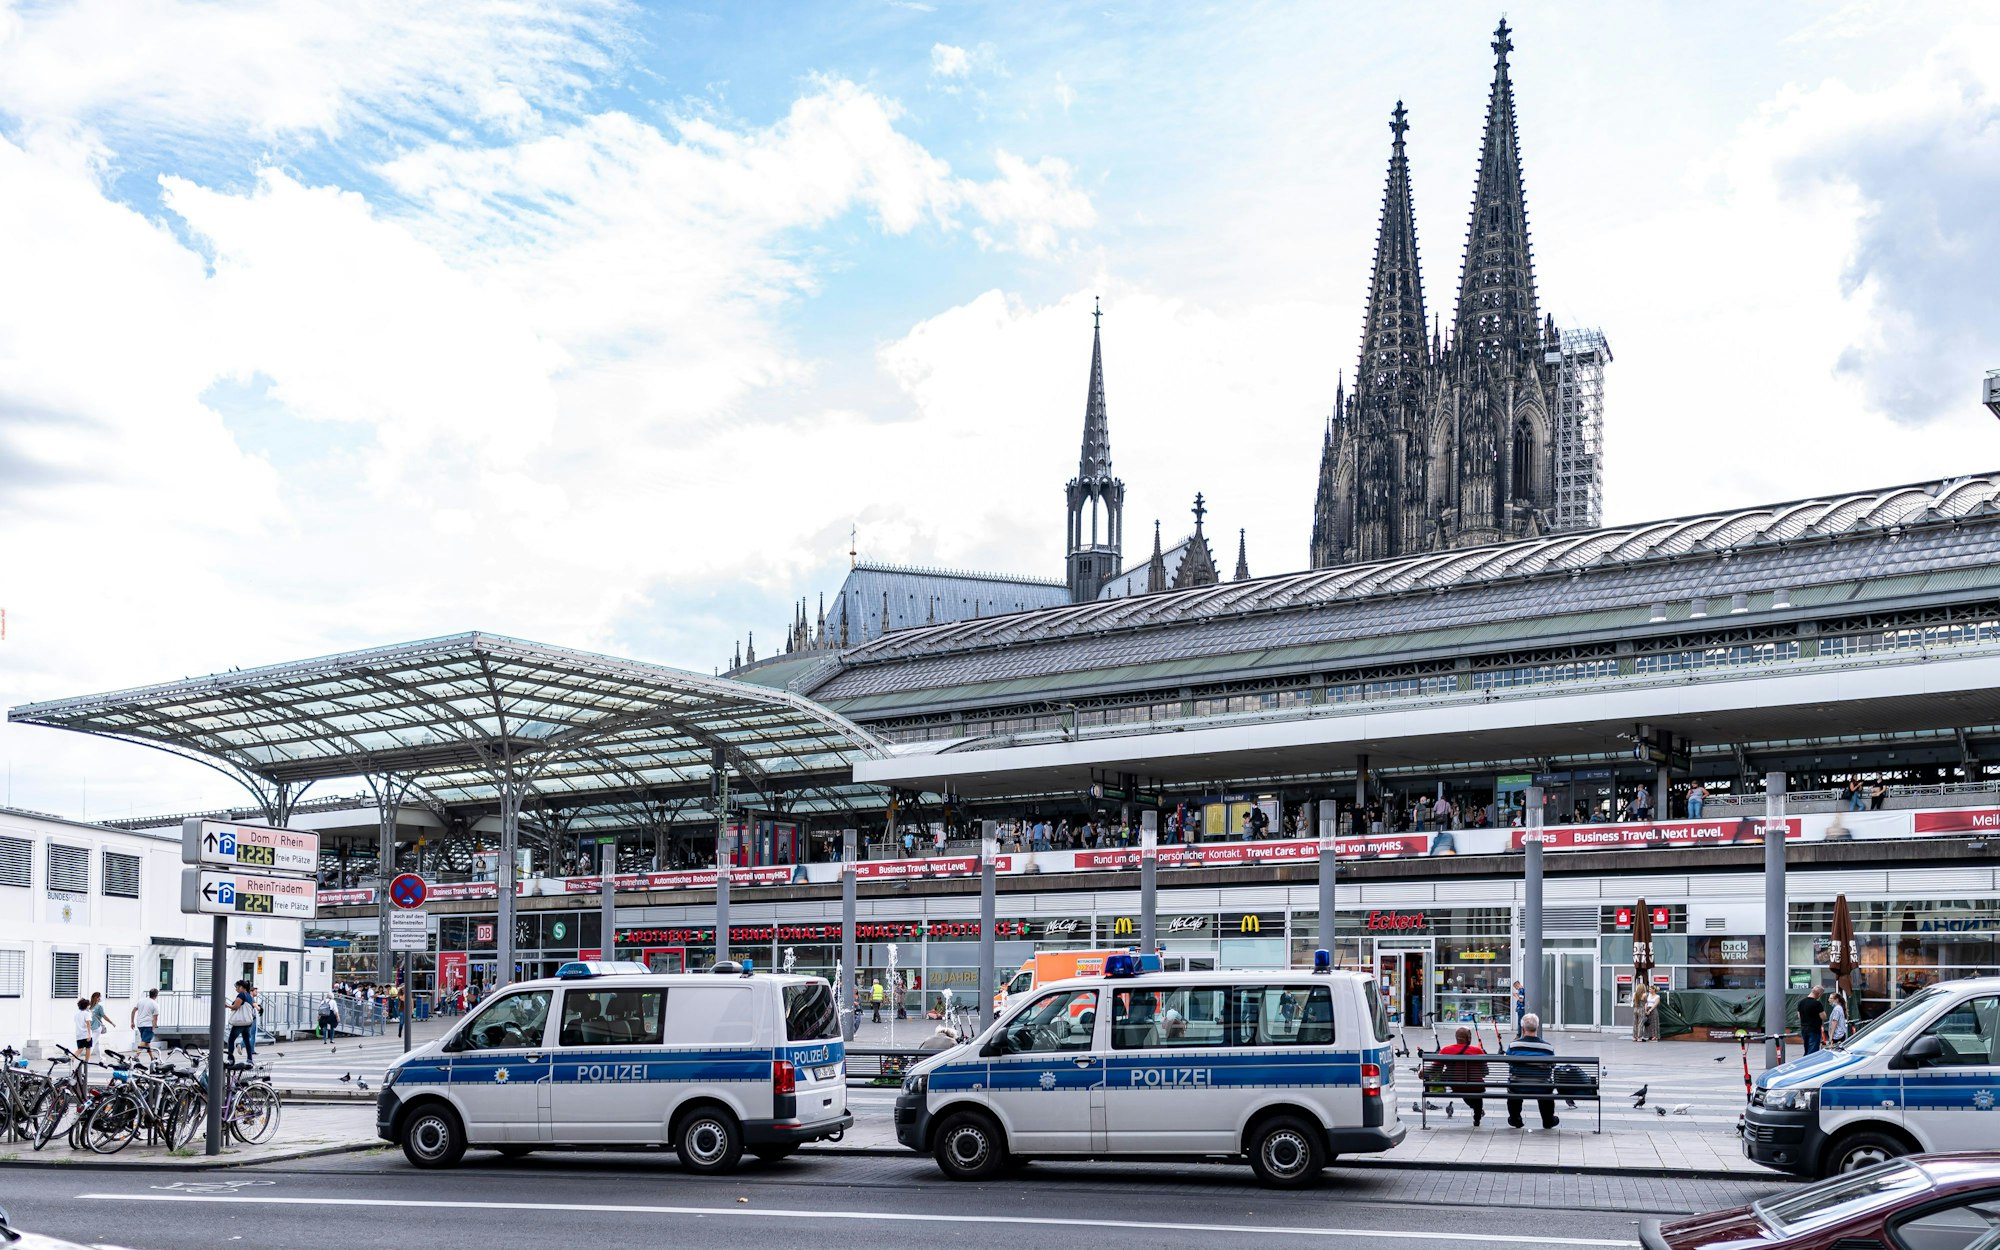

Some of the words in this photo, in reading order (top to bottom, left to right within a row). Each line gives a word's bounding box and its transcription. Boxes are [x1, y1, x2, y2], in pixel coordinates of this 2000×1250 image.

[1972, 814, 2000, 826] Meil
[250, 832, 270, 844] Dom
[280, 836, 304, 848] Rhein
[1574, 832, 1619, 842] Business
[1622, 829, 1658, 840] Travel.
[1661, 828, 1688, 839] Next
[1690, 826, 1724, 838] Level.
[236, 845, 272, 865] 1226
[276, 854, 290, 862] freie
[292, 854, 310, 864] Plätze
[1094, 855, 1113, 864] Rund
[1114, 856, 1127, 864] um
[1128, 853, 1140, 862] die
[1158, 850, 1206, 862] persönlicher
[1208, 850, 1242, 859] Kontakt.
[1246, 847, 1272, 858] Travel
[1275, 846, 1296, 856] Care:
[1300, 844, 1314, 855] ein
[1348, 844, 1364, 853] von
[1367, 841, 1404, 853] myHRS.
[878, 864, 906, 874] Business
[907, 863, 930, 873] Travel.
[930, 862, 946, 872] Next
[948, 861, 968, 871] Level.
[621, 878, 650, 887] mitnehmen.
[654, 876, 692, 885] Automatisches
[734, 871, 753, 880] Vorteil
[766, 870, 788, 881] myHRS.
[247, 880, 303, 894] RheinTriadem
[47, 892, 88, 904] BUNDESPOLIZEI
[244, 894, 271, 912] 224
[274, 900, 288, 909] freie
[290, 902, 309, 911] Plätze
[1368, 910, 1426, 930] Eckert.
[479, 927, 492, 939] DB
[627, 929, 692, 943] APOTHEKE
[712, 926, 818, 942] IERNATIONAL
[824, 924, 904, 940] PHRMACY
[929, 921, 1012, 937] APOTHKE
[1722, 942, 1746, 950] back
[930, 972, 942, 984] 20
[944, 971, 977, 983] JAHRE
[794, 1049, 824, 1066] POLIZEI
[577, 1064, 648, 1080] POLIZEI
[1130, 1068, 1212, 1086] POLIZEI
